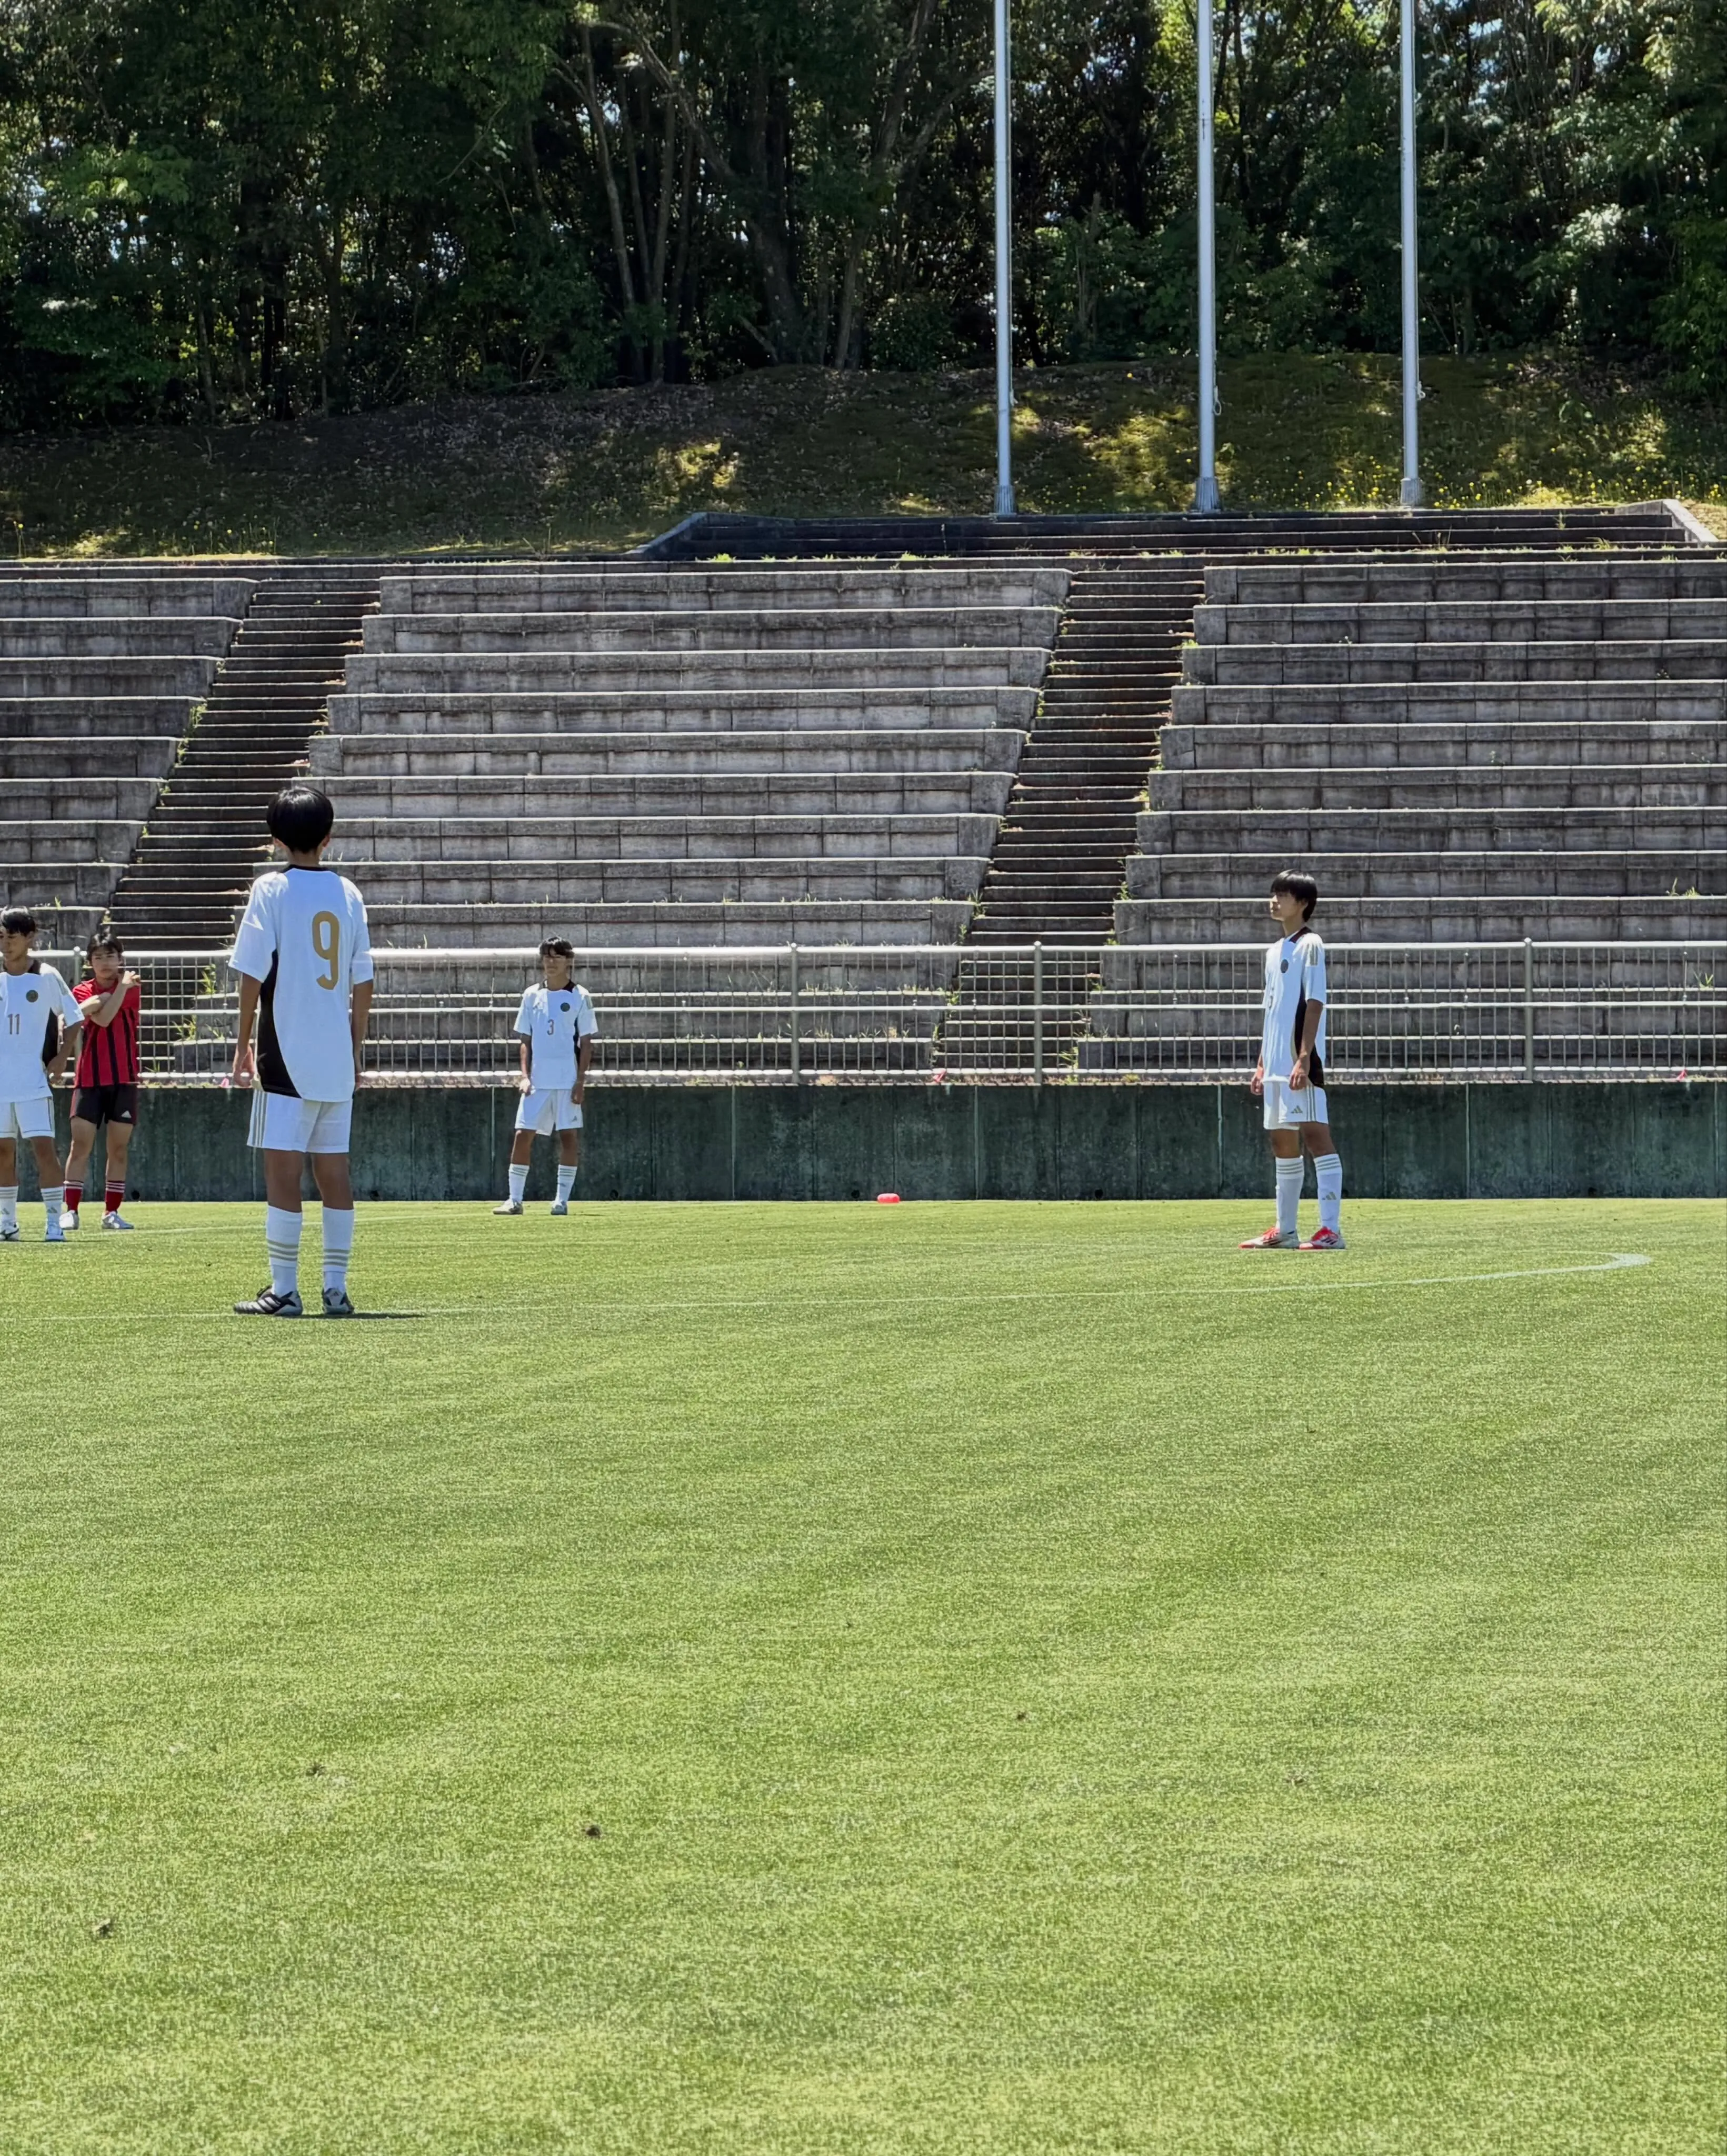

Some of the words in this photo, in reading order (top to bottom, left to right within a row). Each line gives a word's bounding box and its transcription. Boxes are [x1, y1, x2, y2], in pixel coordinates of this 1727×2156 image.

[312, 911, 340, 990] 9
[7, 1013, 20, 1035] 11
[547, 1019, 554, 1036] 3
